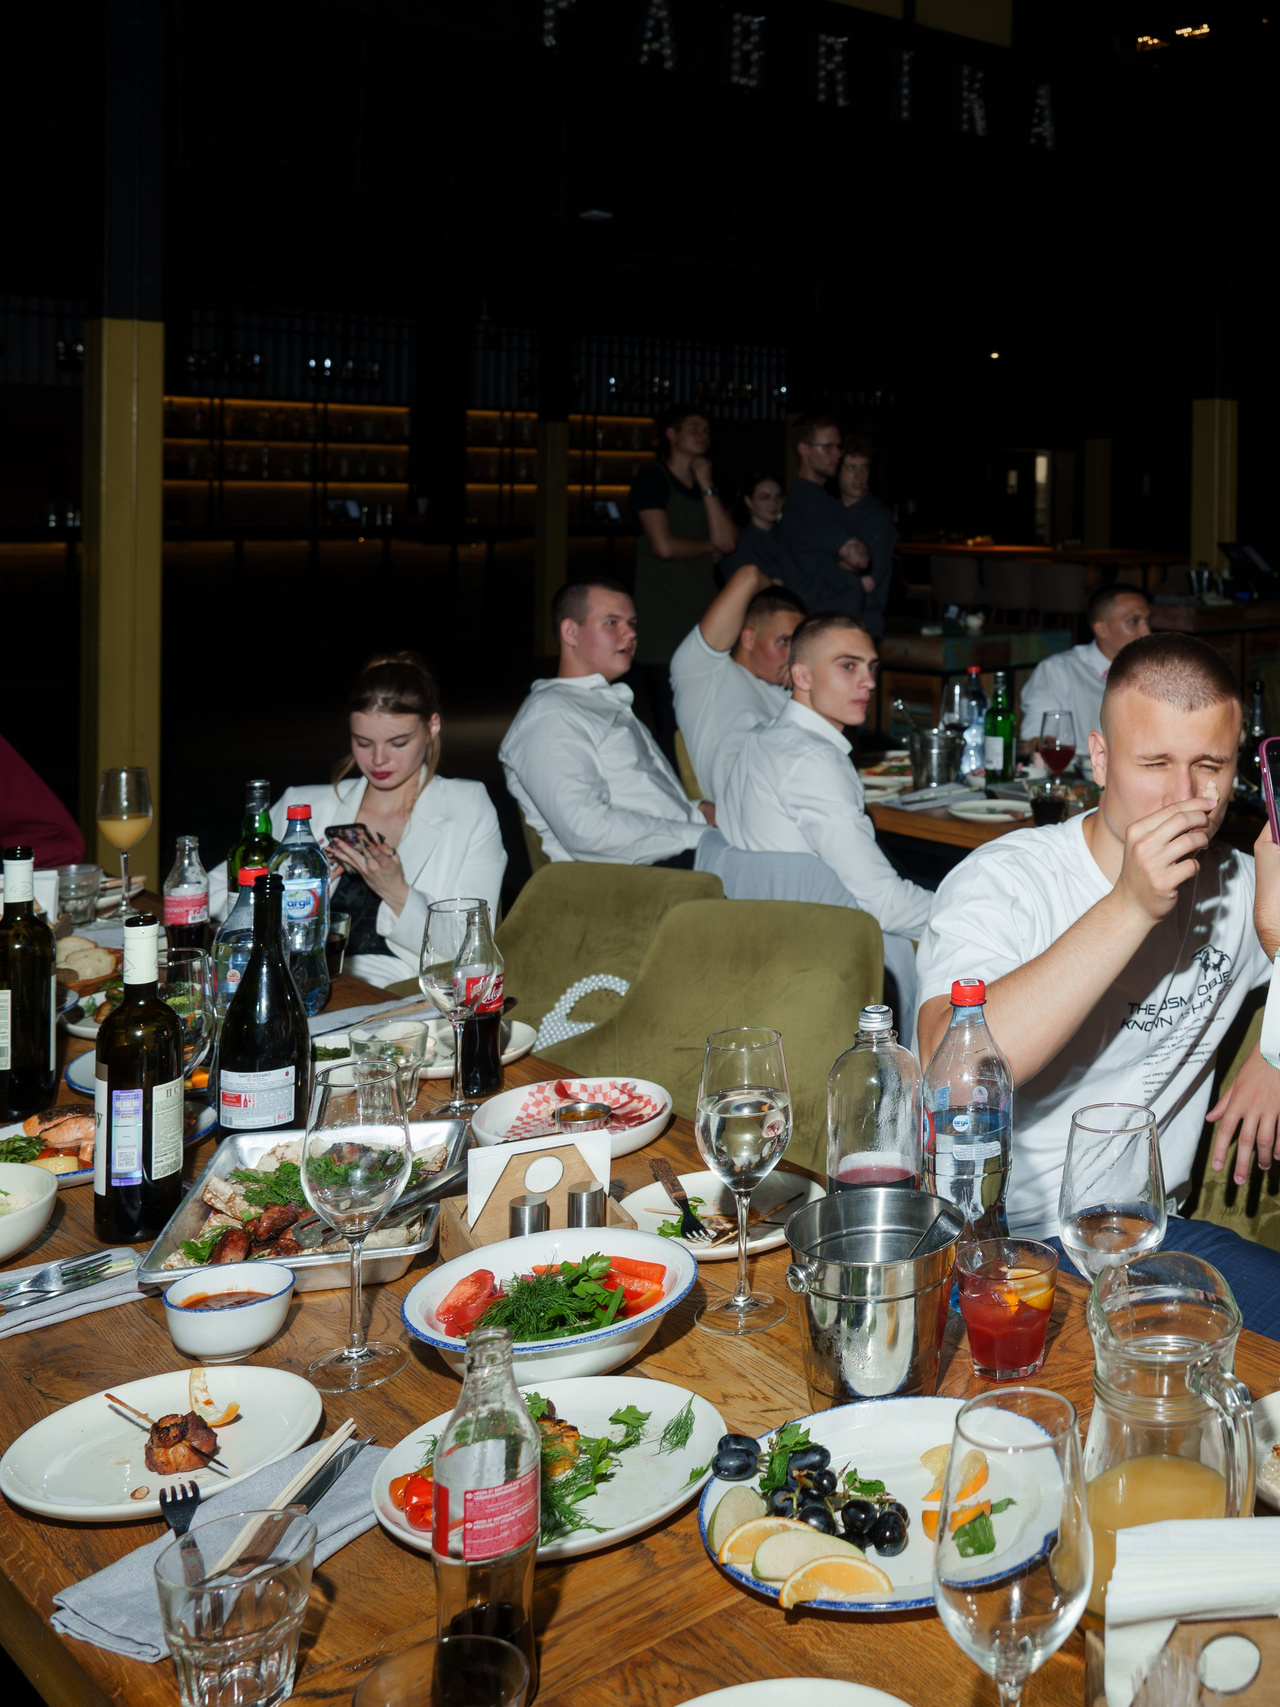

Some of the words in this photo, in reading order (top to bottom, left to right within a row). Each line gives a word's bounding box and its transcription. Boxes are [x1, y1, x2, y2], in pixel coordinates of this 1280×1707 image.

[287, 897, 311, 909] argil
[1128, 1002, 1157, 1016] THE
[1197, 970, 1230, 997] OBJE
